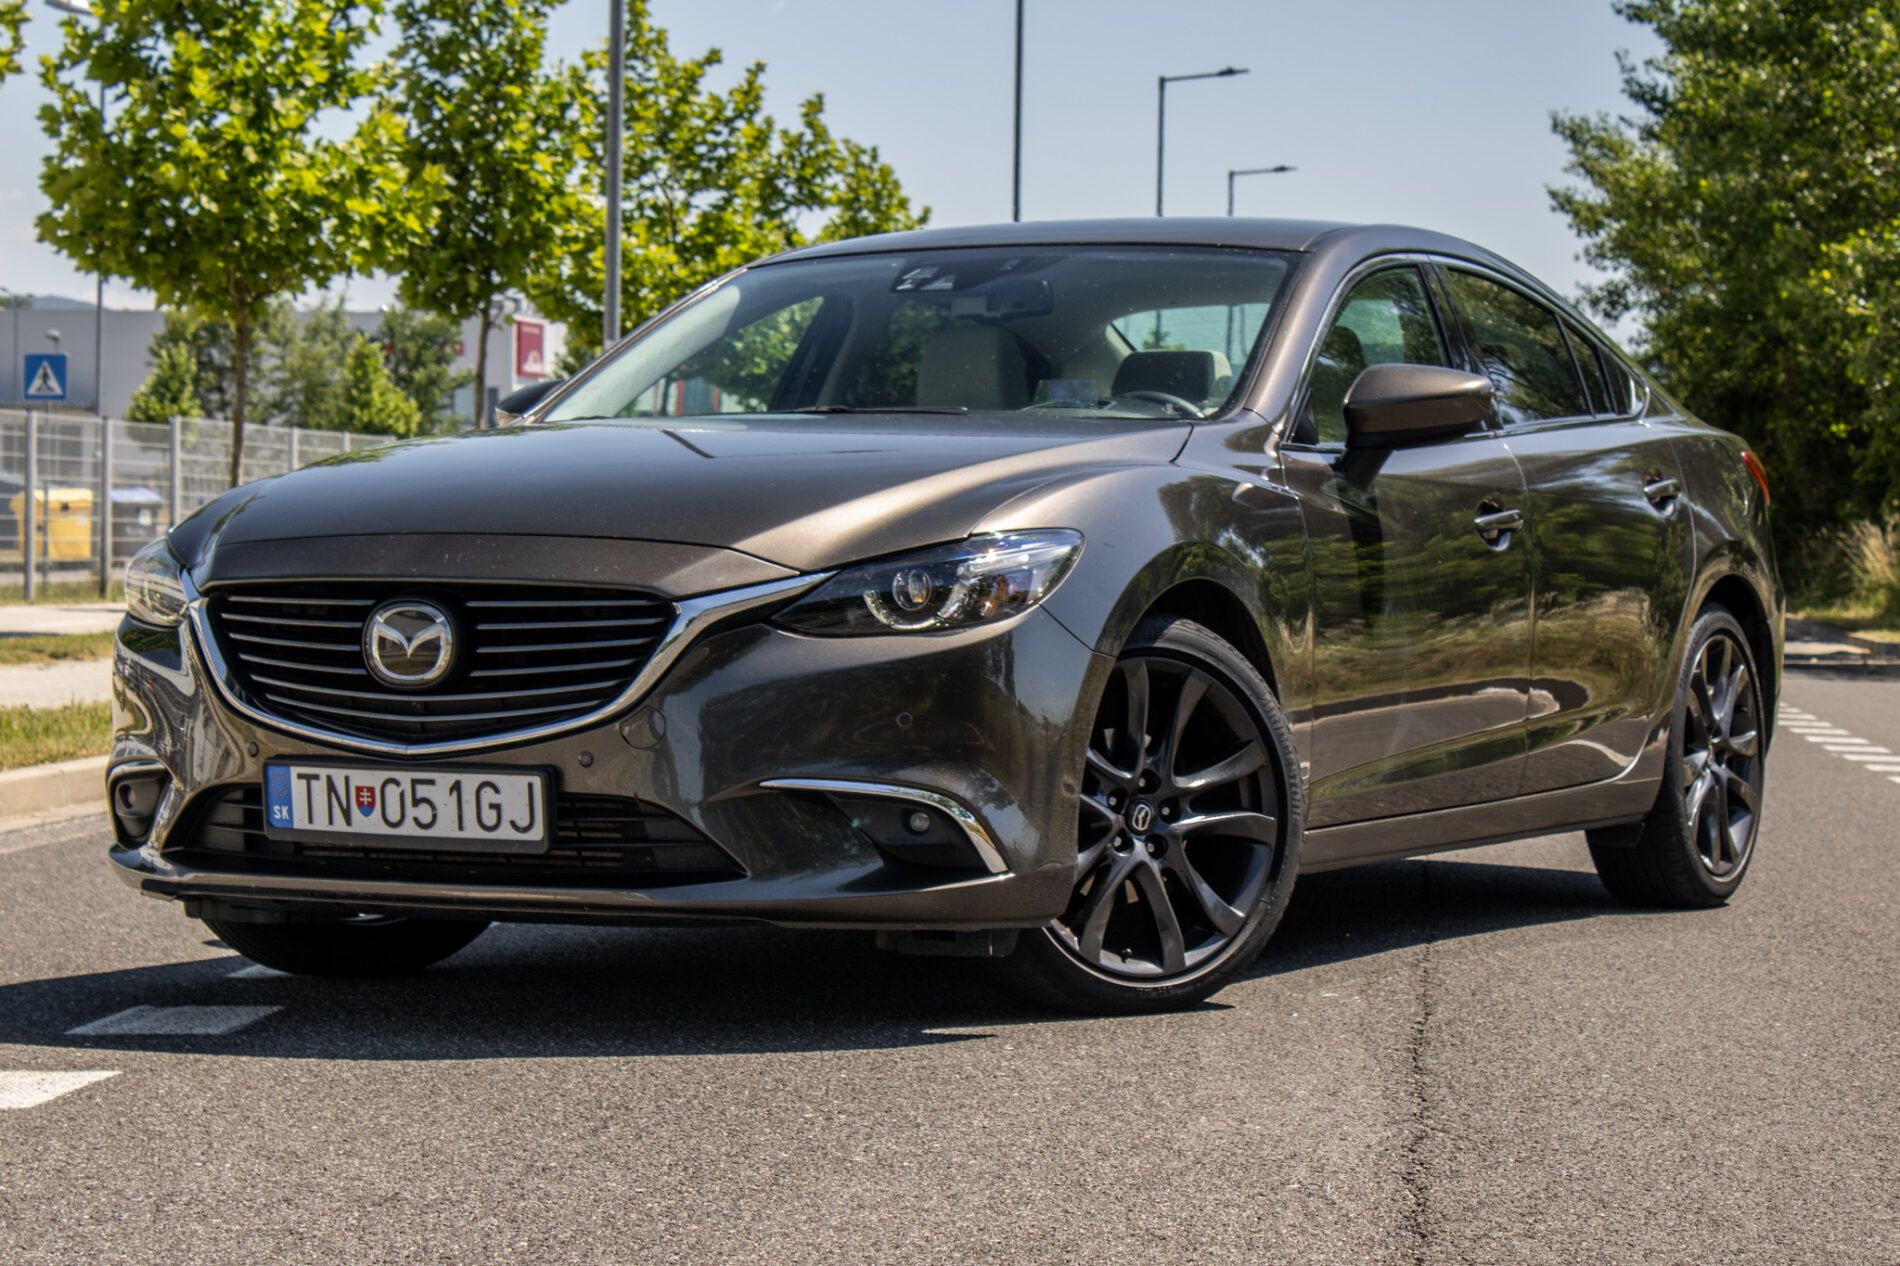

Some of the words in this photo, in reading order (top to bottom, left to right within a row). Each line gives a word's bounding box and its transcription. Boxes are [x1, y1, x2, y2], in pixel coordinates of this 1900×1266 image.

[273, 804, 290, 821] SK
[297, 773, 353, 827] TN
[379, 777, 536, 834] 051GJ
